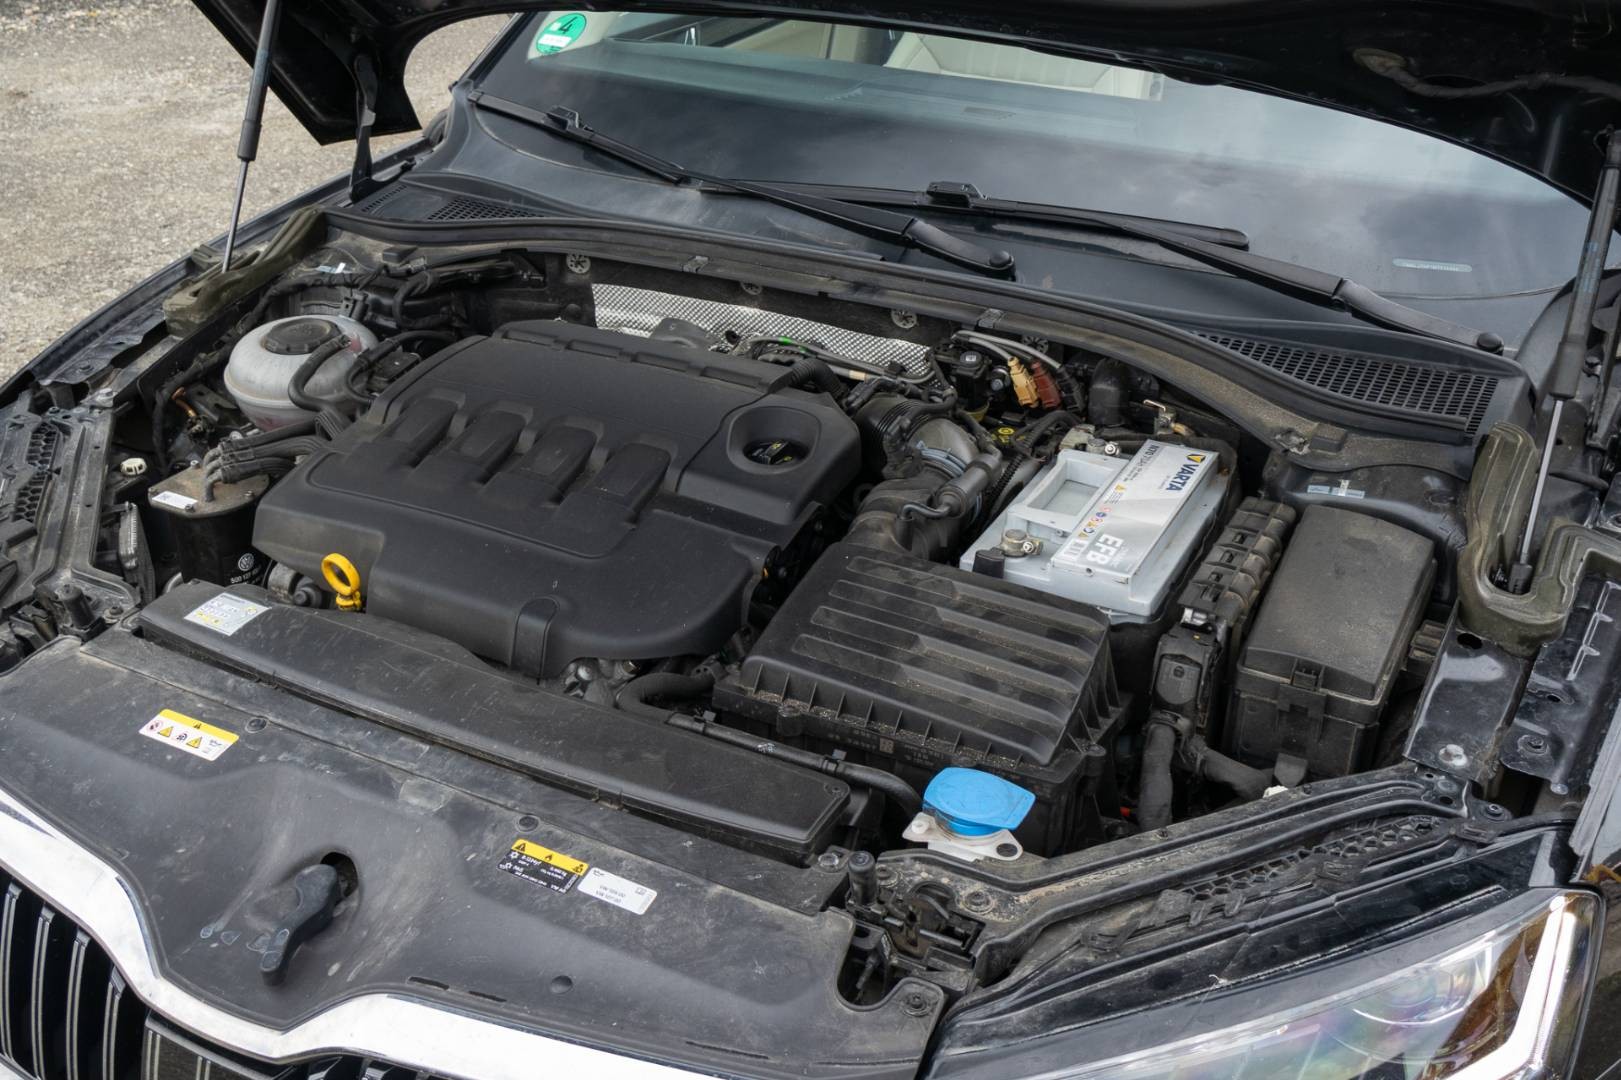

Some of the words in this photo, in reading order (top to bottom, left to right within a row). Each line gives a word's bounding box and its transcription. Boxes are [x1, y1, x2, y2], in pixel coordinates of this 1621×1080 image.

[558, 16, 578, 34] 4
[1165, 463, 1199, 492] VARTA
[1086, 534, 1124, 565] EFB
